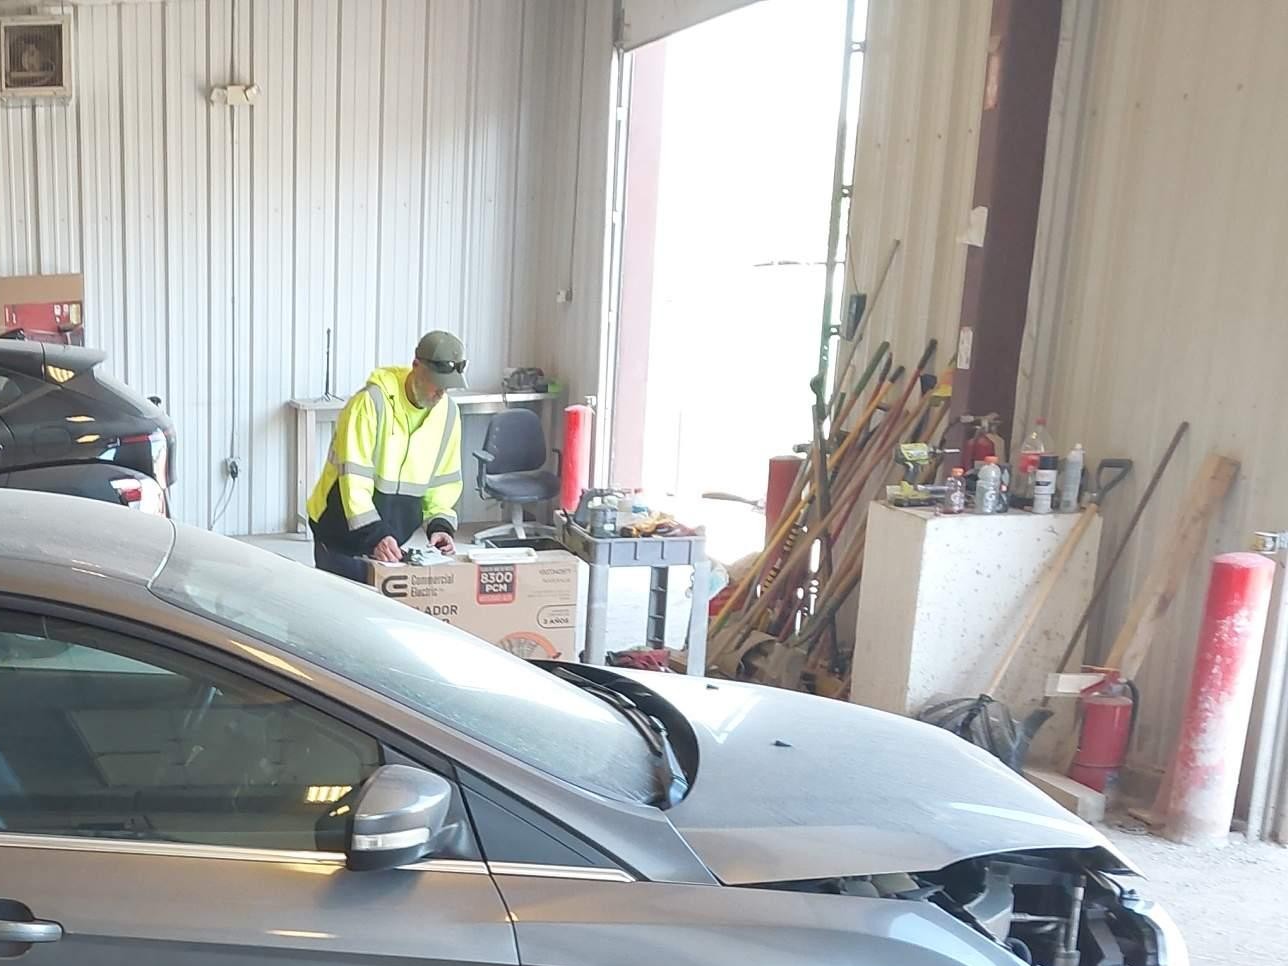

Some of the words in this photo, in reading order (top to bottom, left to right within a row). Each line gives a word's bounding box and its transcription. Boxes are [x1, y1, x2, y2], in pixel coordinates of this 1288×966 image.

[411, 573, 455, 585] Commercial
[480, 572, 513, 584] 8300
[411, 587, 438, 597] Electric
